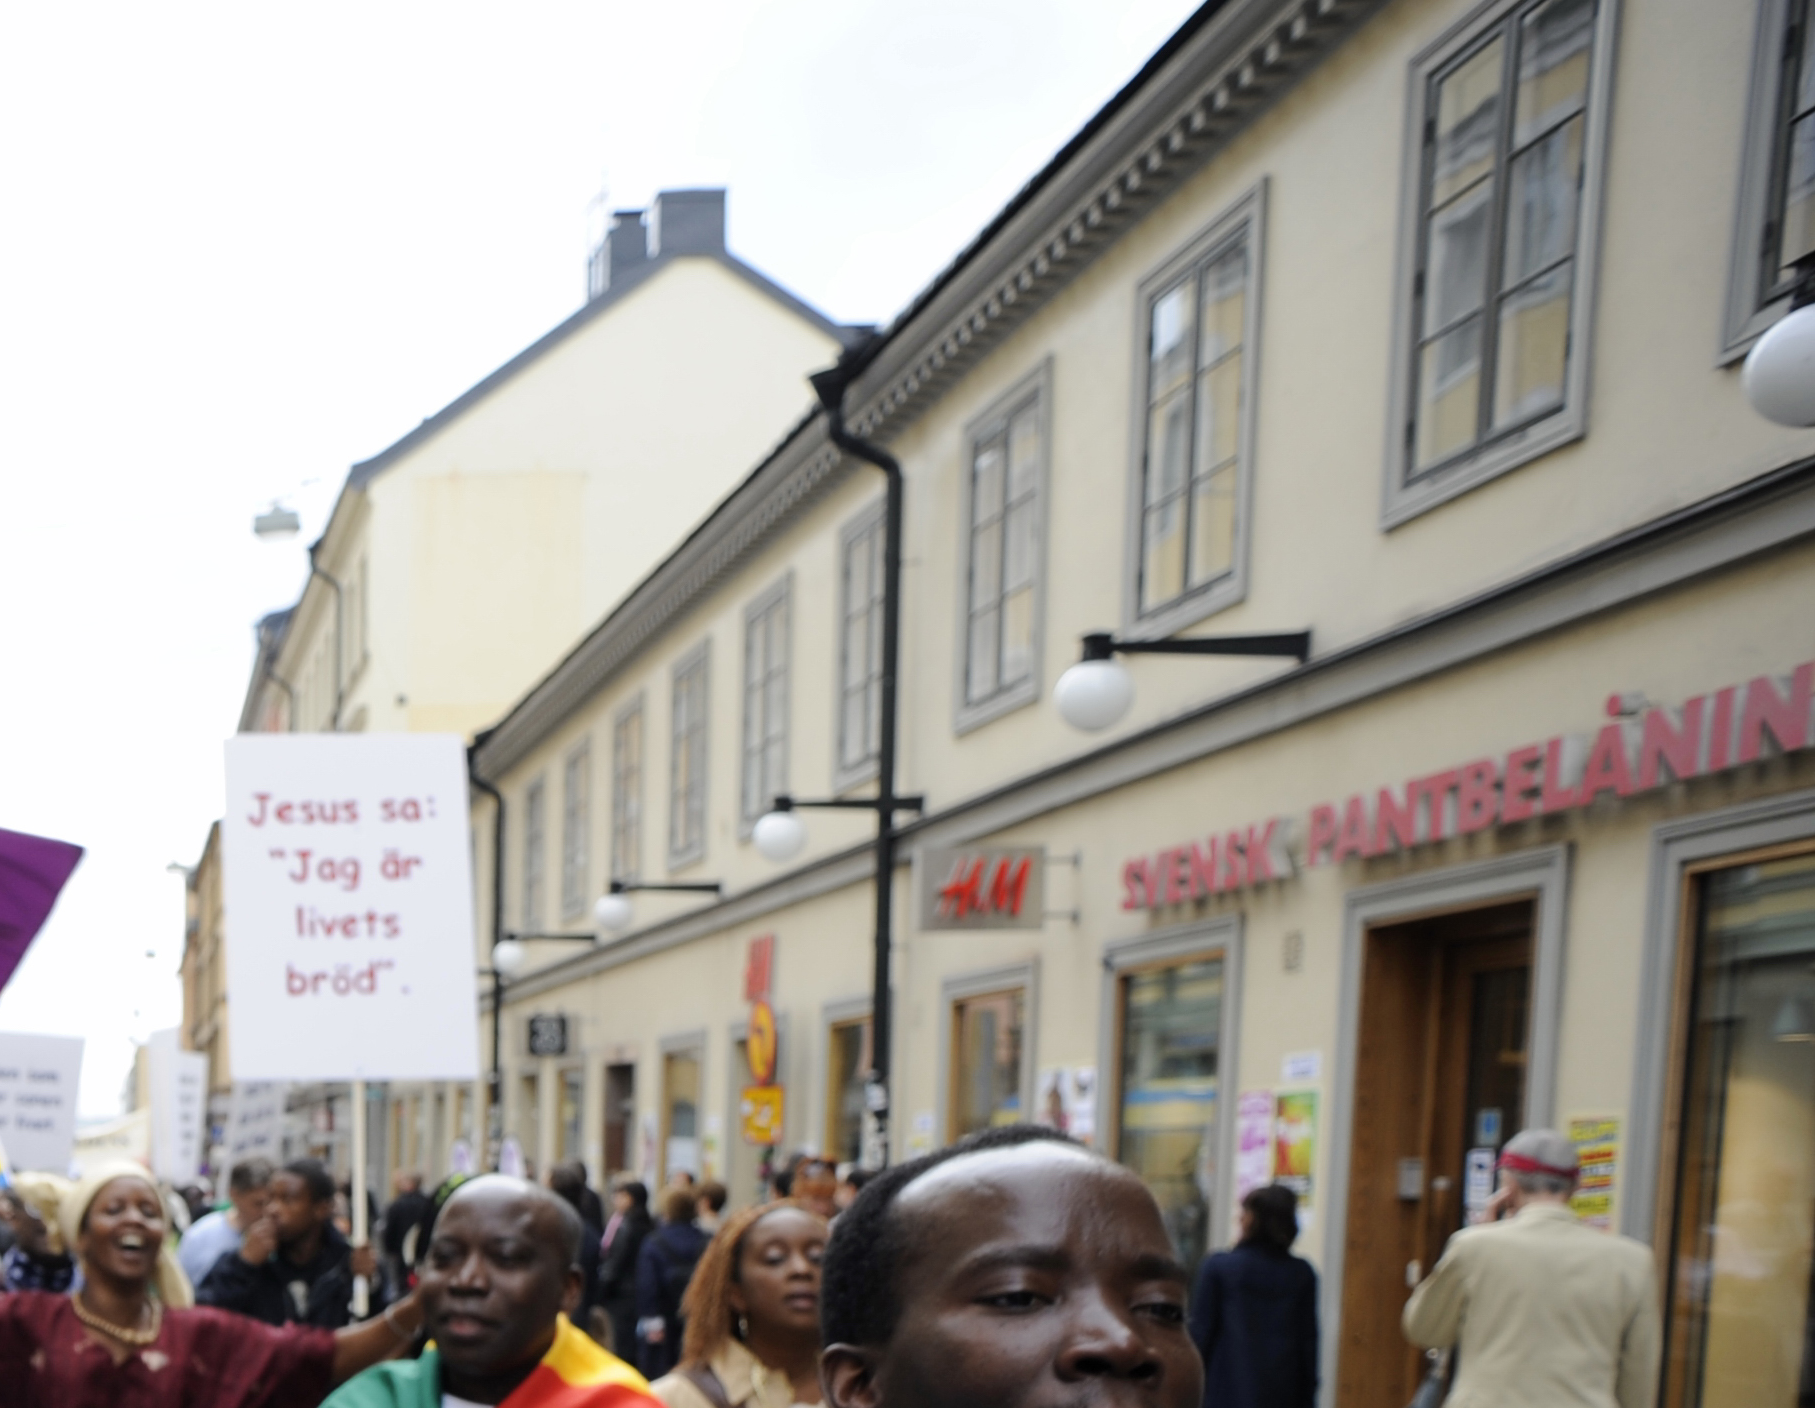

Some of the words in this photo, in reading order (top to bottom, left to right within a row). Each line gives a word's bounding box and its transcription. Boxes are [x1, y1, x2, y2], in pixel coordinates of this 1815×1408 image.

[248, 793, 359, 828] Jesus
[380, 796, 437, 823] sa:
[269, 849, 361, 892] "Jag
[380, 847, 422, 881] är
[1120, 818, 1279, 911] SVENSK
[295, 904, 401, 939] livets
